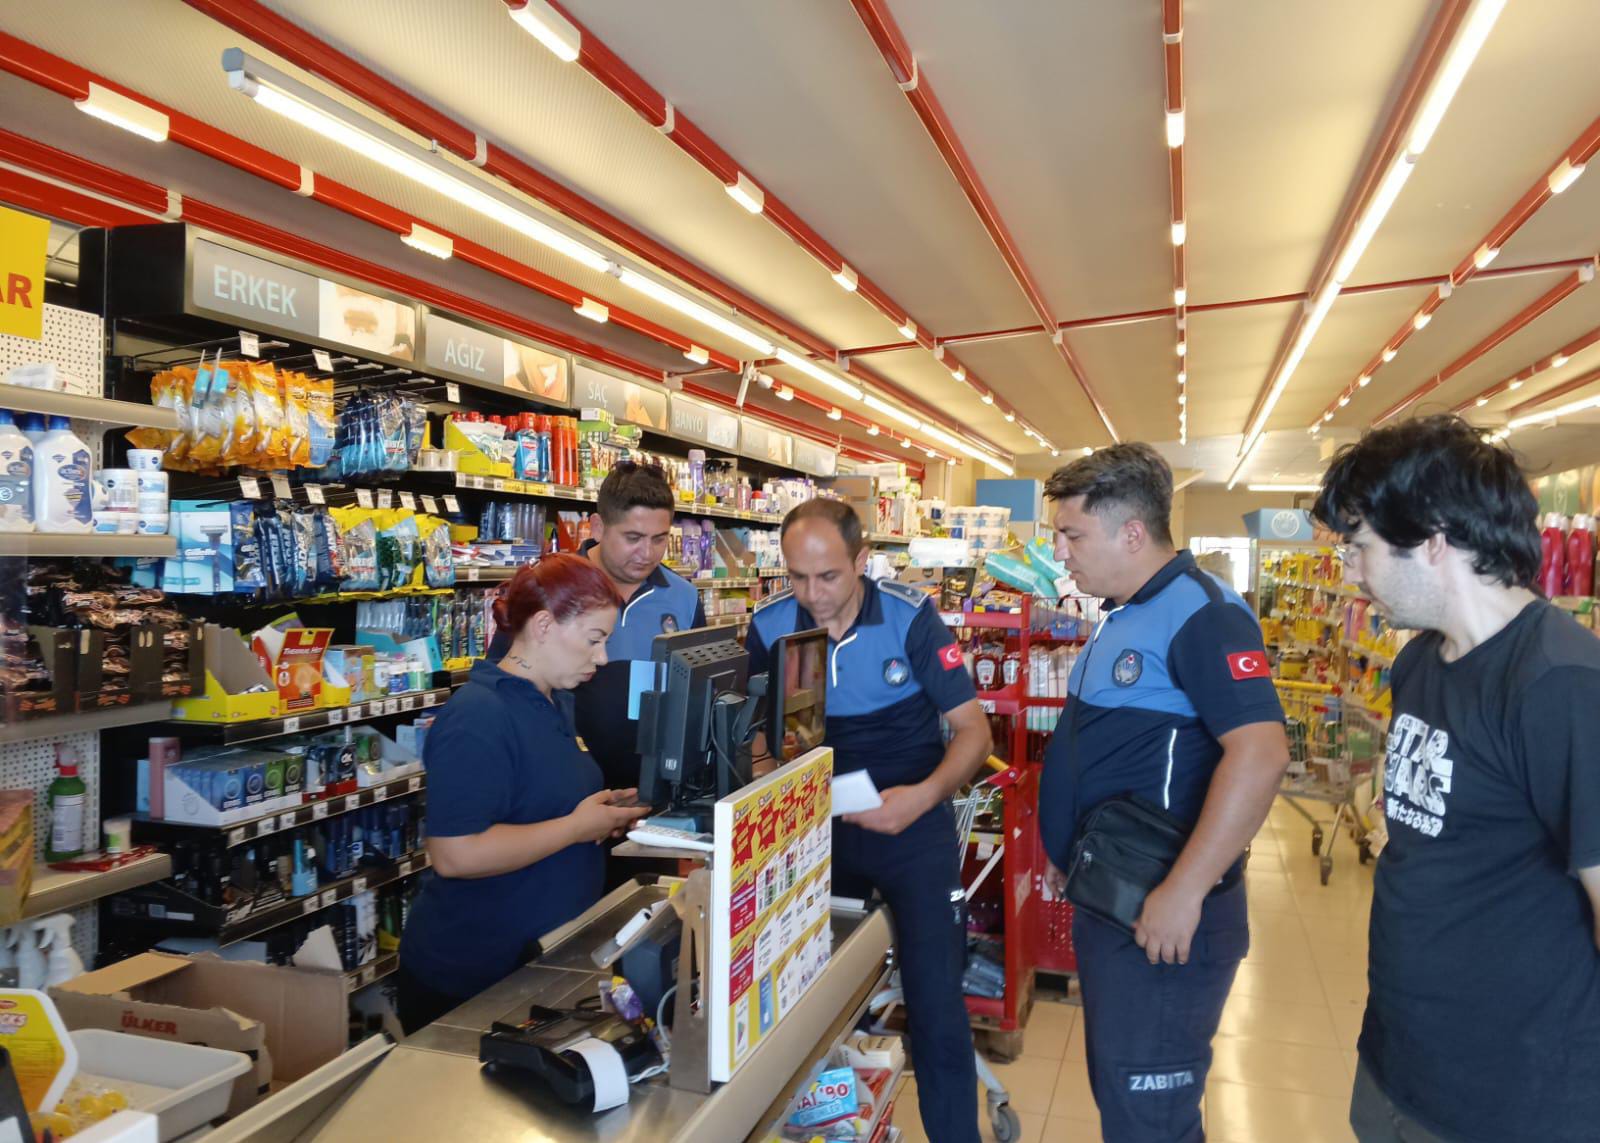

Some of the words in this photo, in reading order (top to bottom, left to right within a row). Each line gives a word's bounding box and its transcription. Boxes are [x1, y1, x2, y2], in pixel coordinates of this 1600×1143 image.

[0, 272, 32, 308] R
[214, 264, 297, 318] ERKEK
[588, 380, 609, 409] SAÇ
[674, 409, 703, 433] BANYO
[122, 1011, 177, 1034] ÜLKER
[1129, 1070, 1194, 1091] ZABITA
